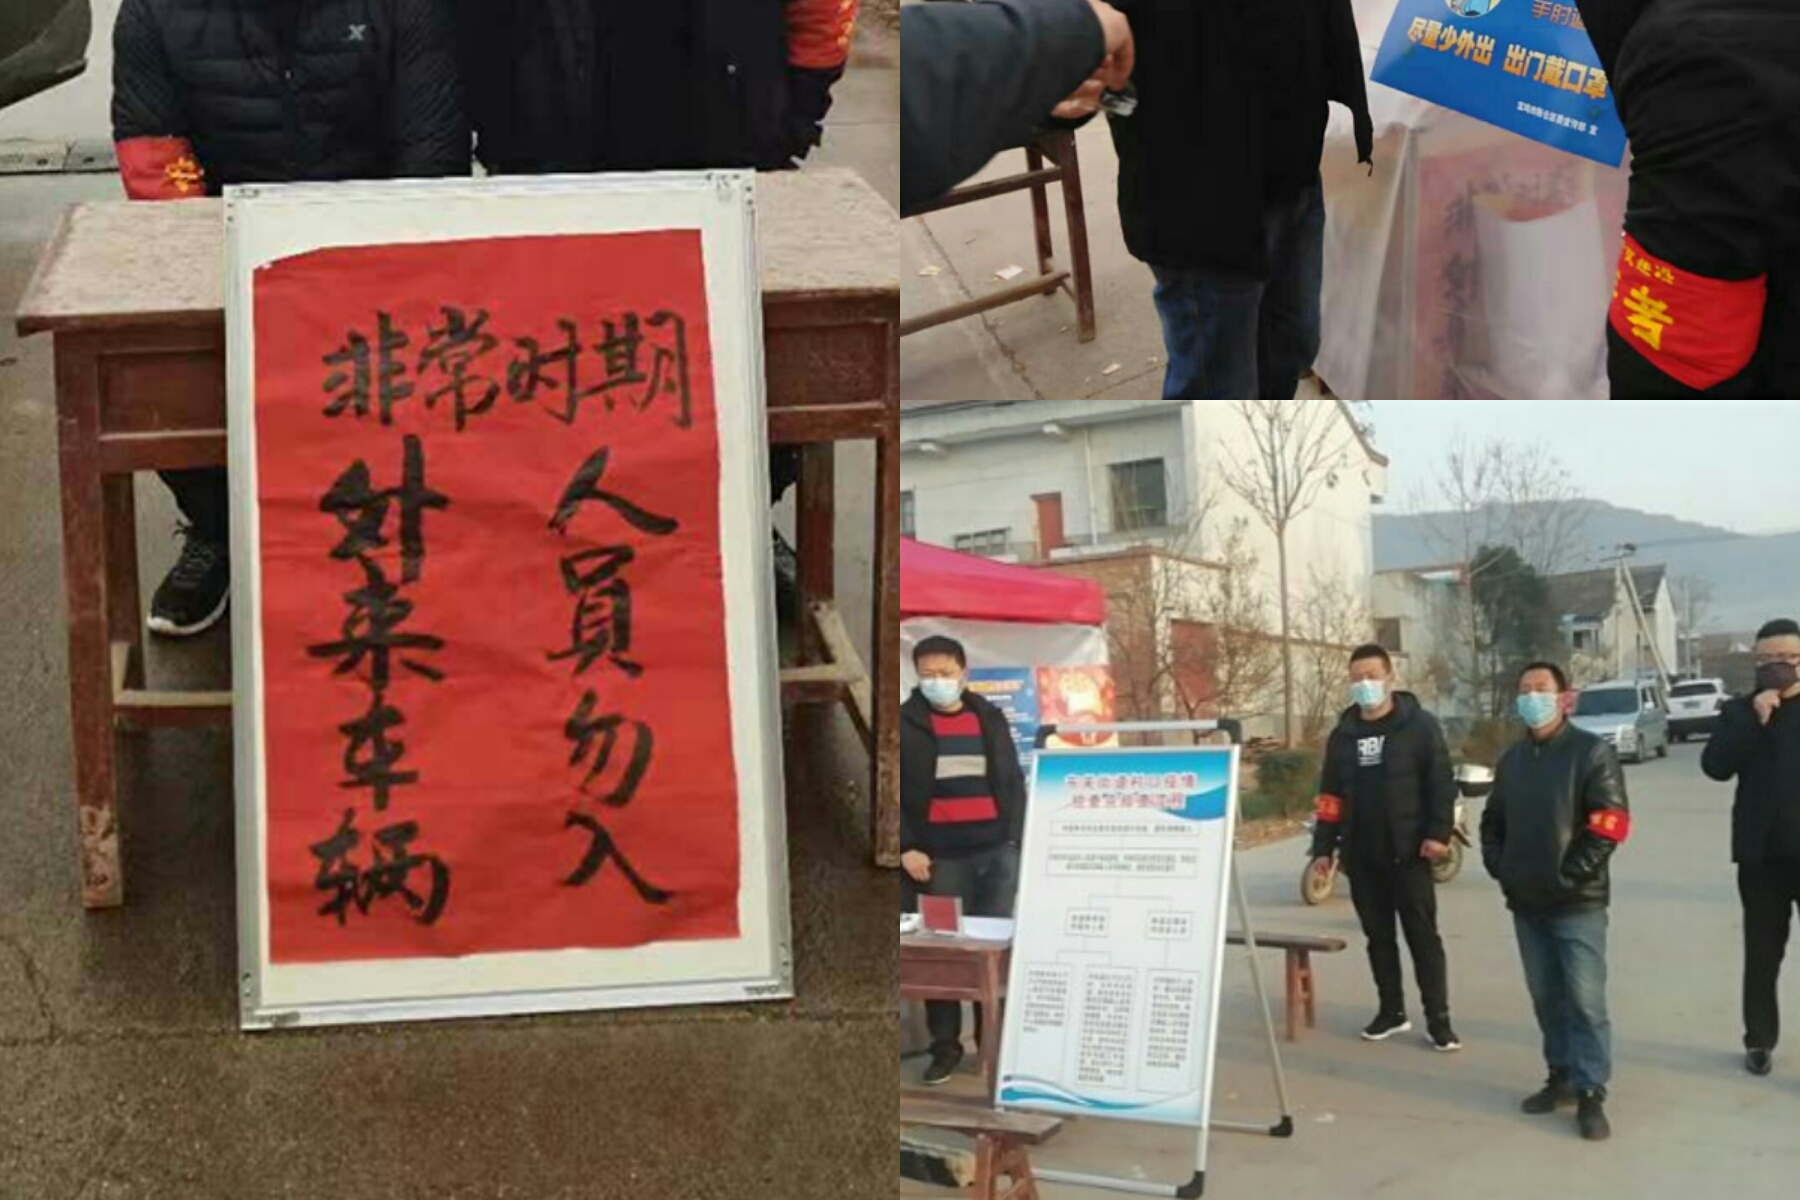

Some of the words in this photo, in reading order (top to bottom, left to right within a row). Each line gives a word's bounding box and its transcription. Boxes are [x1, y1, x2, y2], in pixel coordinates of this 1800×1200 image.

[1407, 16, 1496, 67] 尽量少外出
[1502, 43, 1609, 99] 出门戴口罩
[321, 306, 692, 431] 非常时期
[307, 434, 452, 928] 外来车辆
